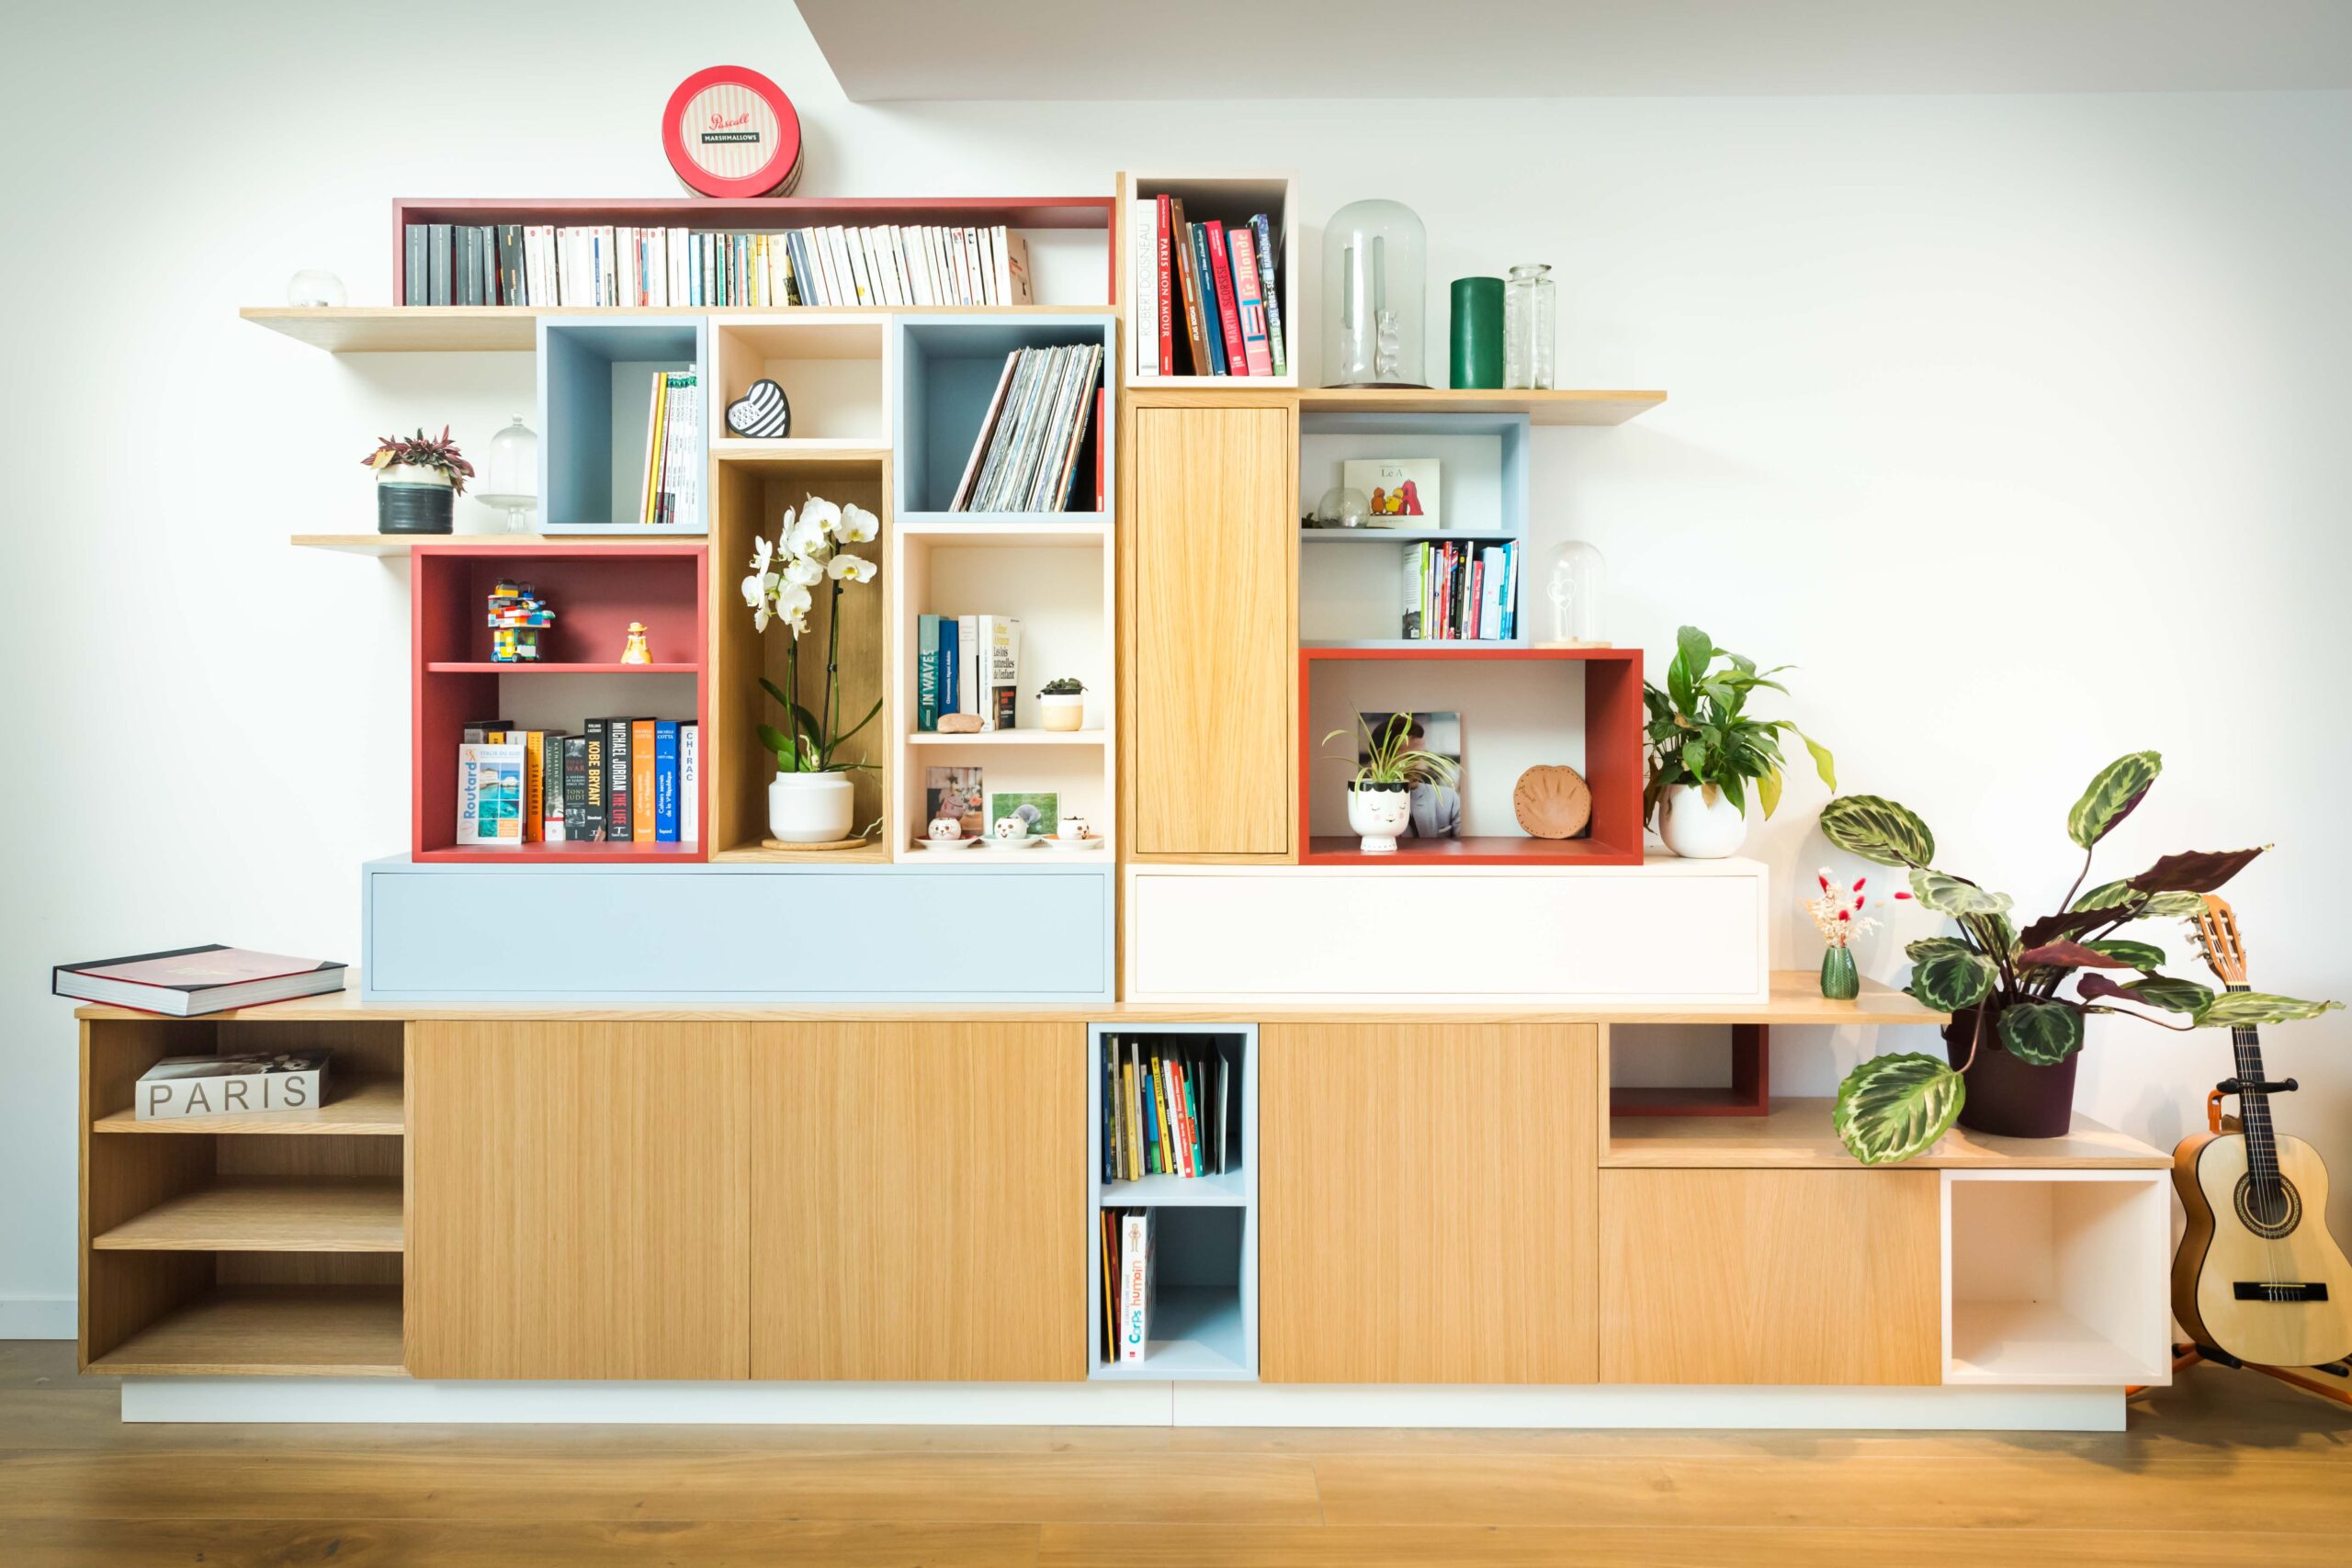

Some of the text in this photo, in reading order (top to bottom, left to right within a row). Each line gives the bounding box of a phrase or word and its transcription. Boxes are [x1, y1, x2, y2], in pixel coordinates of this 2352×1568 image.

[708, 113, 750, 130] Pascall
[1160, 238, 1169, 267] PARIS
[1236, 233, 1254, 281] Monde
[1139, 223, 1151, 336] ROBERT DOISNEAU
[1160, 271, 1170, 296] MON
[1160, 299, 1170, 338] AMOUR
[1217, 265, 1238, 344] MARTIN SCORSESE
[1382, 468, 1403, 477] Le A
[922, 649, 934, 705] IN WAVES
[612, 722, 627, 757] MICHAEL
[463, 761, 477, 819] Routard
[531, 764, 539, 816] STALINGRAD
[589, 741, 600, 807] KOBE BRYANT
[612, 758, 627, 791] JORDAN
[612, 793, 627, 807] THE
[612, 808, 627, 824] LIFE
[150, 1076, 306, 1116] PARIS
[1128, 1260, 1143, 1344] Corps humain
